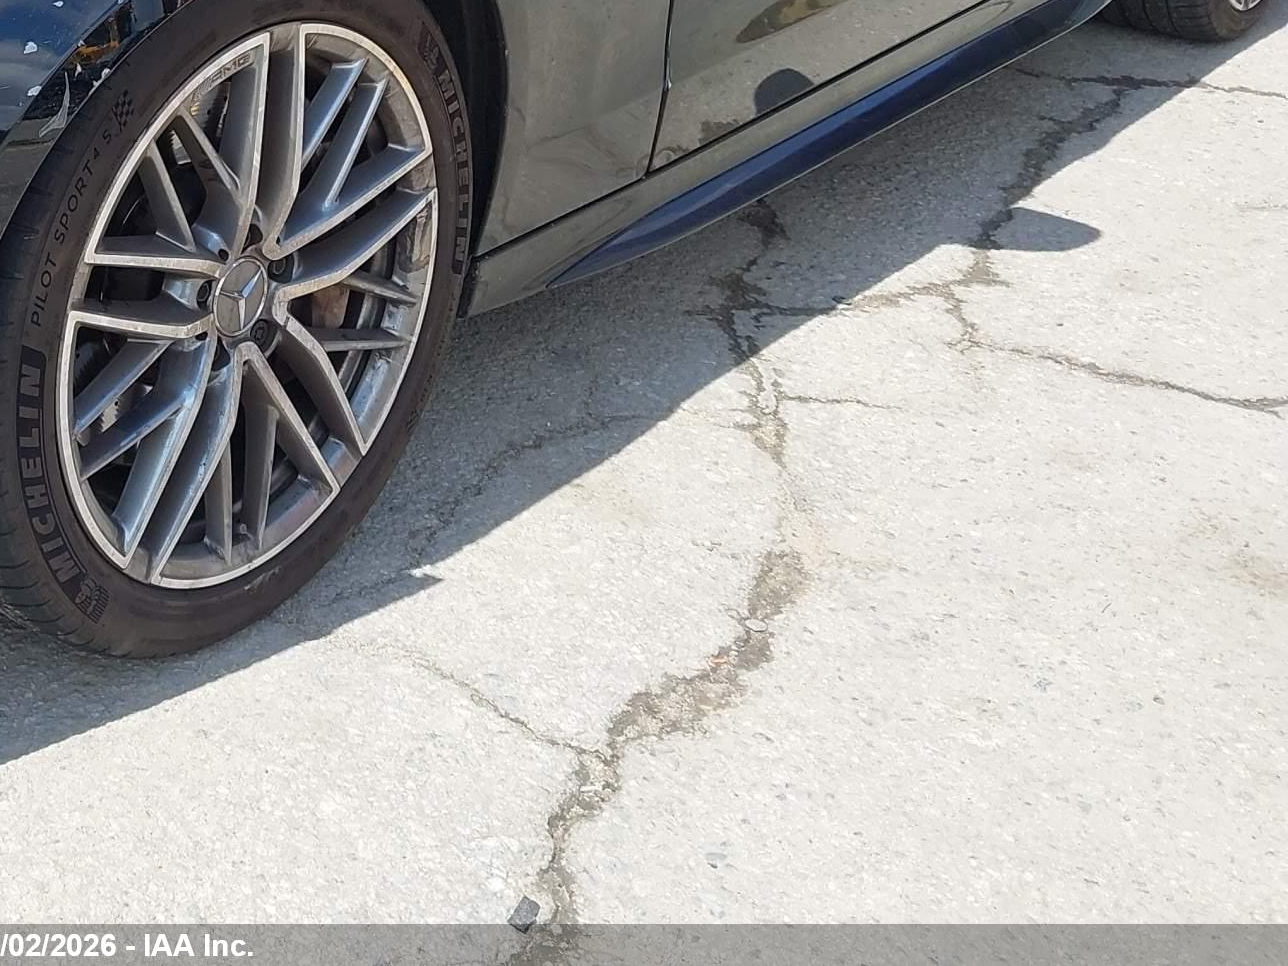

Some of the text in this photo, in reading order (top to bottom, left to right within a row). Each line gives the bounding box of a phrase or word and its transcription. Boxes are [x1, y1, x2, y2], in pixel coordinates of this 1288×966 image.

[30, 256, 58, 327] PILOT
[53, 163, 94, 245] SPORT
[102, 129, 113, 145] S
[438, 70, 470, 262] MICHELIN
[18, 363, 81, 584] MICHELIN
